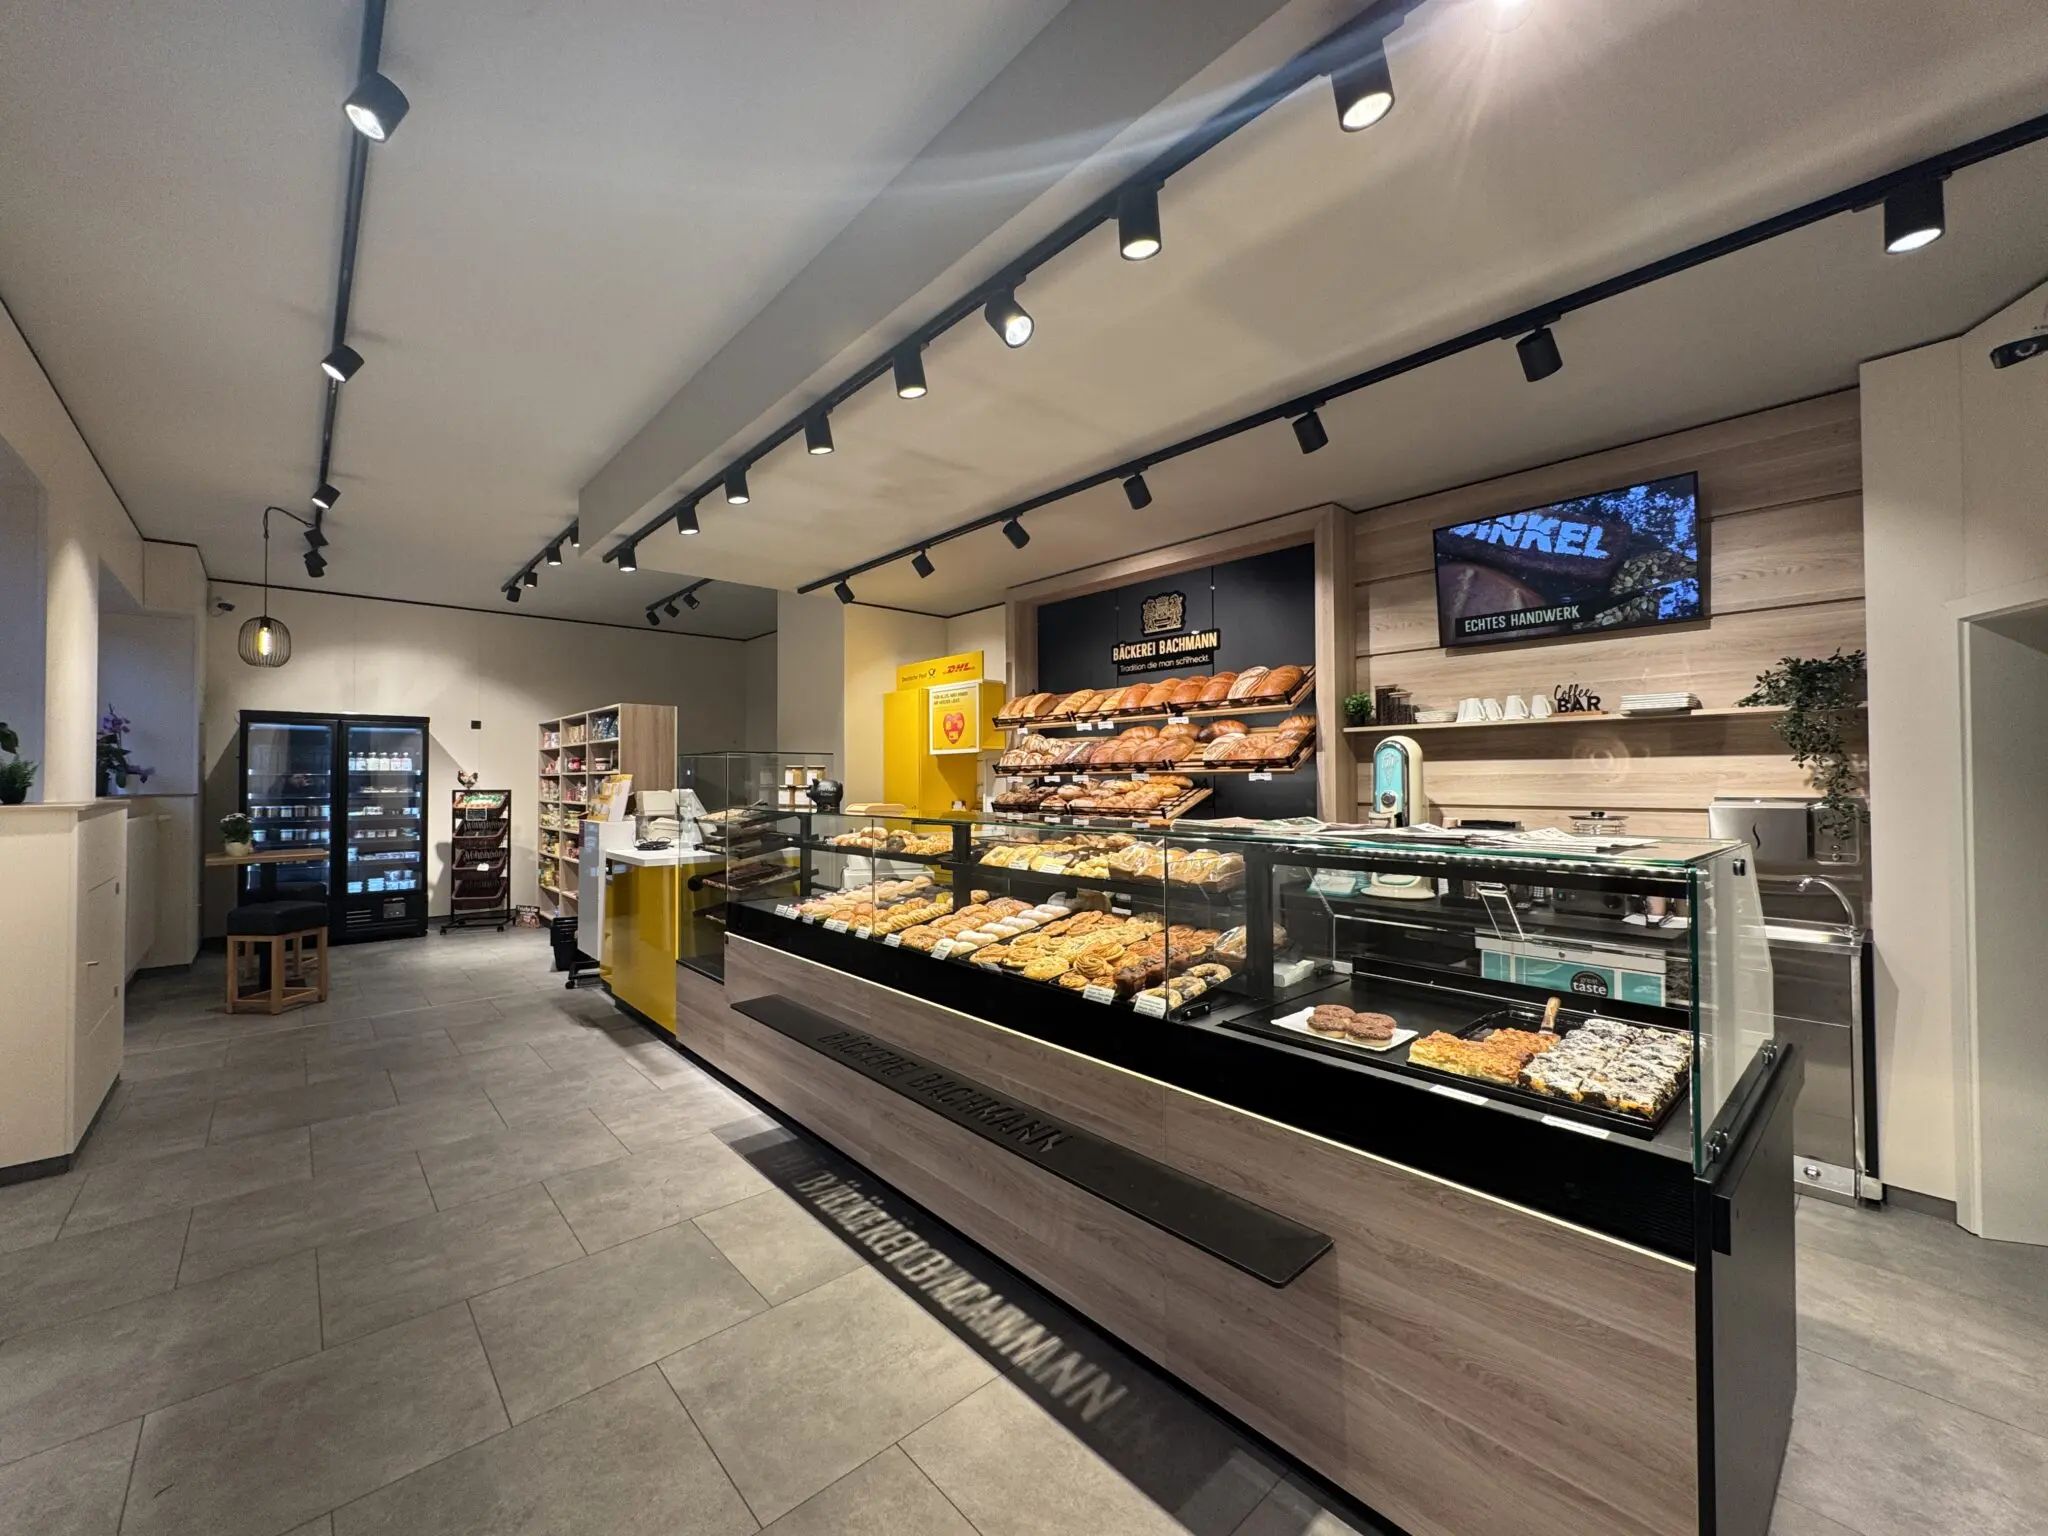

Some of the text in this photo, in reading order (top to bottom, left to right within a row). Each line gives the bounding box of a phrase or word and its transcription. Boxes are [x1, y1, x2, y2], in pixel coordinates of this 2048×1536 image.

[1464, 604, 1580, 632] ECHTES HANDWERK
[1112, 631, 1218, 661] BÄCKEREI BACHMANN
[946, 662, 971, 674] DHL
[1120, 663, 1147, 673] Tradition
[1147, 661, 1157, 669] die
[1159, 660, 1174, 668] man
[1554, 684, 1593, 704] Coffee
[1557, 695, 1601, 713] BAR
[1572, 982, 1607, 995] taste
[906, 1072, 1073, 1153] BACHMANN
